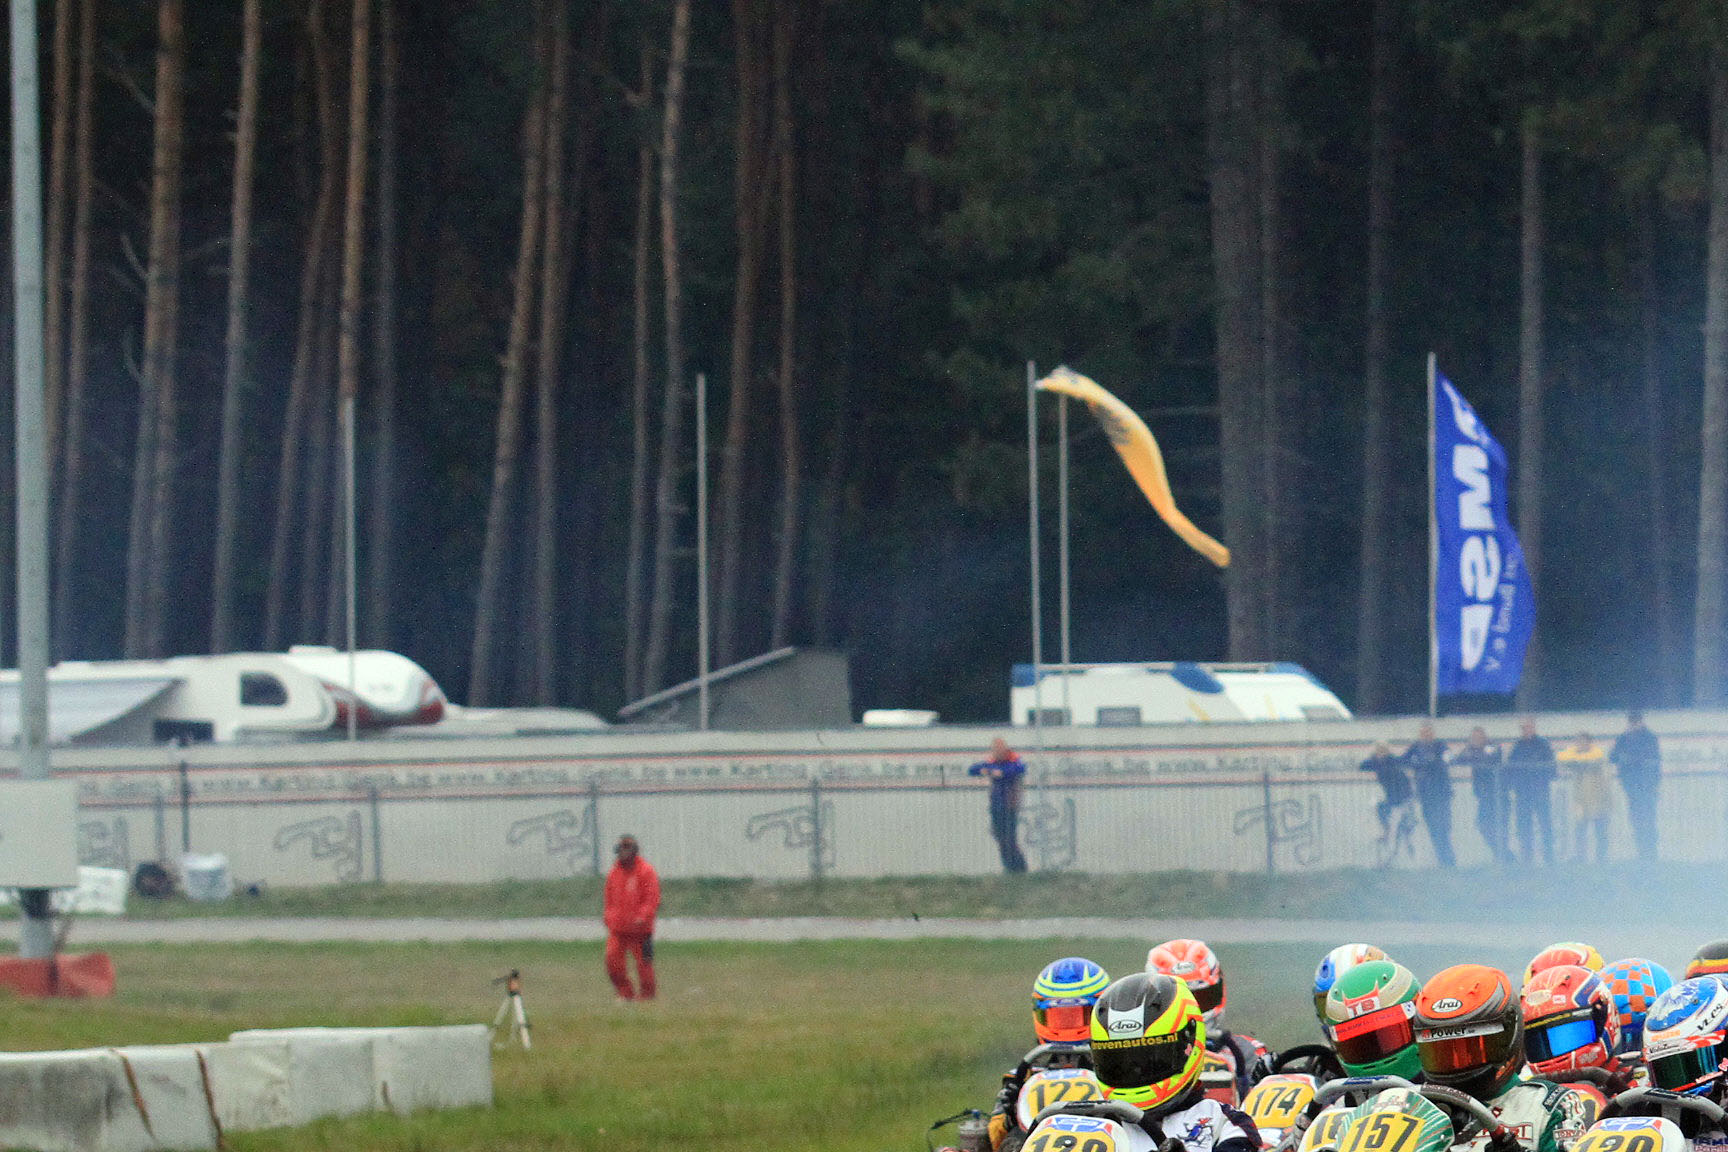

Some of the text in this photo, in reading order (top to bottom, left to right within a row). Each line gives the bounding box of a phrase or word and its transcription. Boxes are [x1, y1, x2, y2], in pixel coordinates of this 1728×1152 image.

[1432, 999, 1459, 1011] Arai
[1111, 1020, 1140, 1031] Arai
[1252, 1087, 1302, 1117] 174
